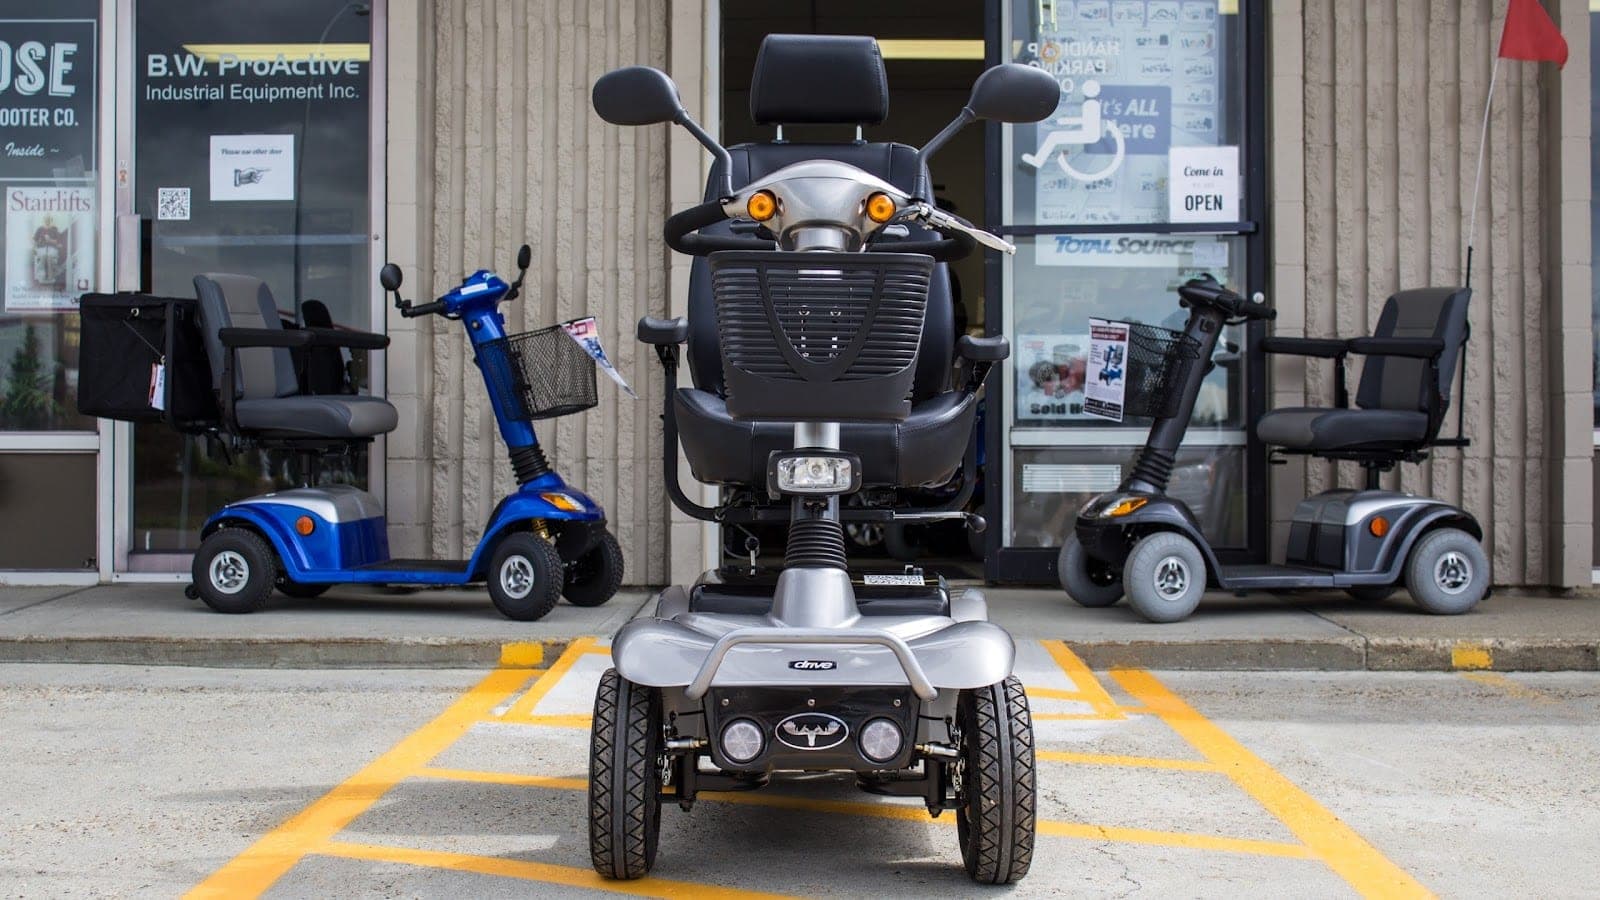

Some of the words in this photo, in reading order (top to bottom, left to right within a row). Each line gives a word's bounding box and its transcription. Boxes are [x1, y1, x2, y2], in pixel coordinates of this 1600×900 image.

[147, 54, 208, 77] B.W.
[218, 54, 360, 76] ProActive
[146, 84, 224, 100] Industrial
[230, 83, 324, 103] Equipment
[329, 83, 359, 99] Inc.
[1100, 99, 1121, 116] t's
[1123, 98, 1160, 116] ALL
[0, 108, 49, 127] OOTER
[54, 108, 79, 127] CO.
[5, 142, 45, 157] Inside
[1184, 166, 1210, 177] Come
[1212, 165, 1224, 177] in
[11, 190, 90, 212] Stairlifts
[1185, 194, 1223, 211] OPEN
[1030, 402, 1066, 415] Sold
[794, 660, 833, 669] drive
